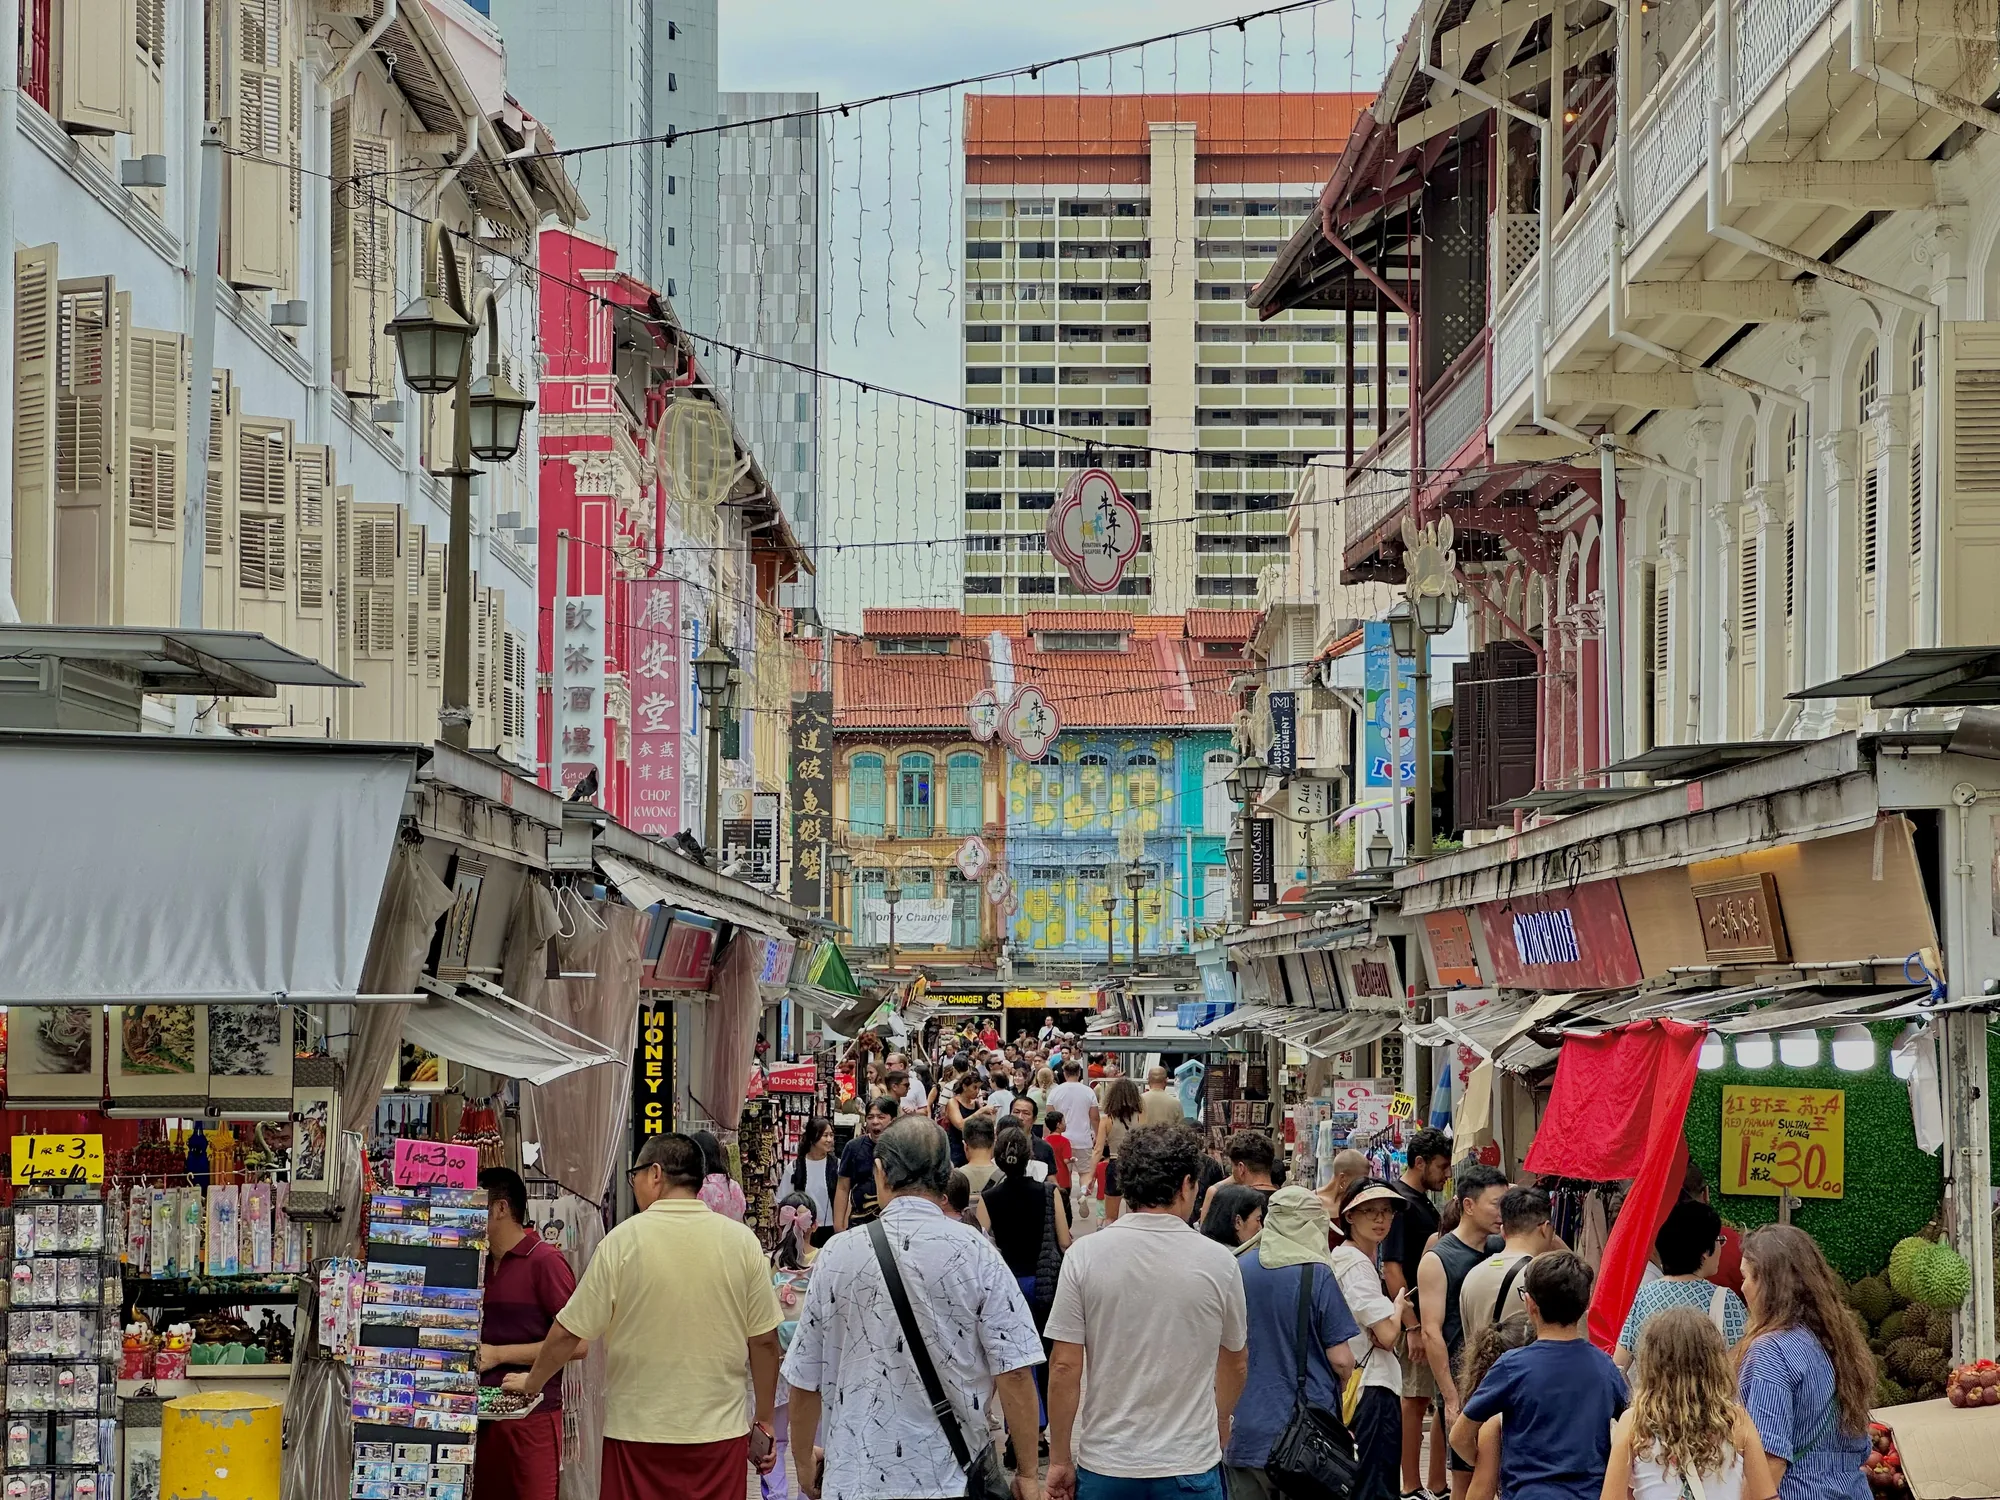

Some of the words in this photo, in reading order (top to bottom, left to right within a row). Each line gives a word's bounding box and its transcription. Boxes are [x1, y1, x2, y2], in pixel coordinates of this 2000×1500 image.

[640, 790, 671, 801] CHOP
[634, 806, 676, 818] KWONG
[642, 823, 668, 834] ONN
[1253, 822, 1263, 882] UNIQCASH
[948, 995, 983, 1004] CHANGER
[644, 1012, 664, 1093] MONEY
[771, 1077, 779, 1085] 10
[1392, 1099, 1411, 1116] $10
[1724, 1118, 1741, 1128] RED
[1778, 1118, 1810, 1129] SULTAN
[28, 1137, 35, 1159] 1
[405, 1144, 414, 1161] 1
[1753, 1152, 1776, 1163] FOR
[20, 1164, 41, 1179] 4
[399, 1166, 413, 1184] 4
